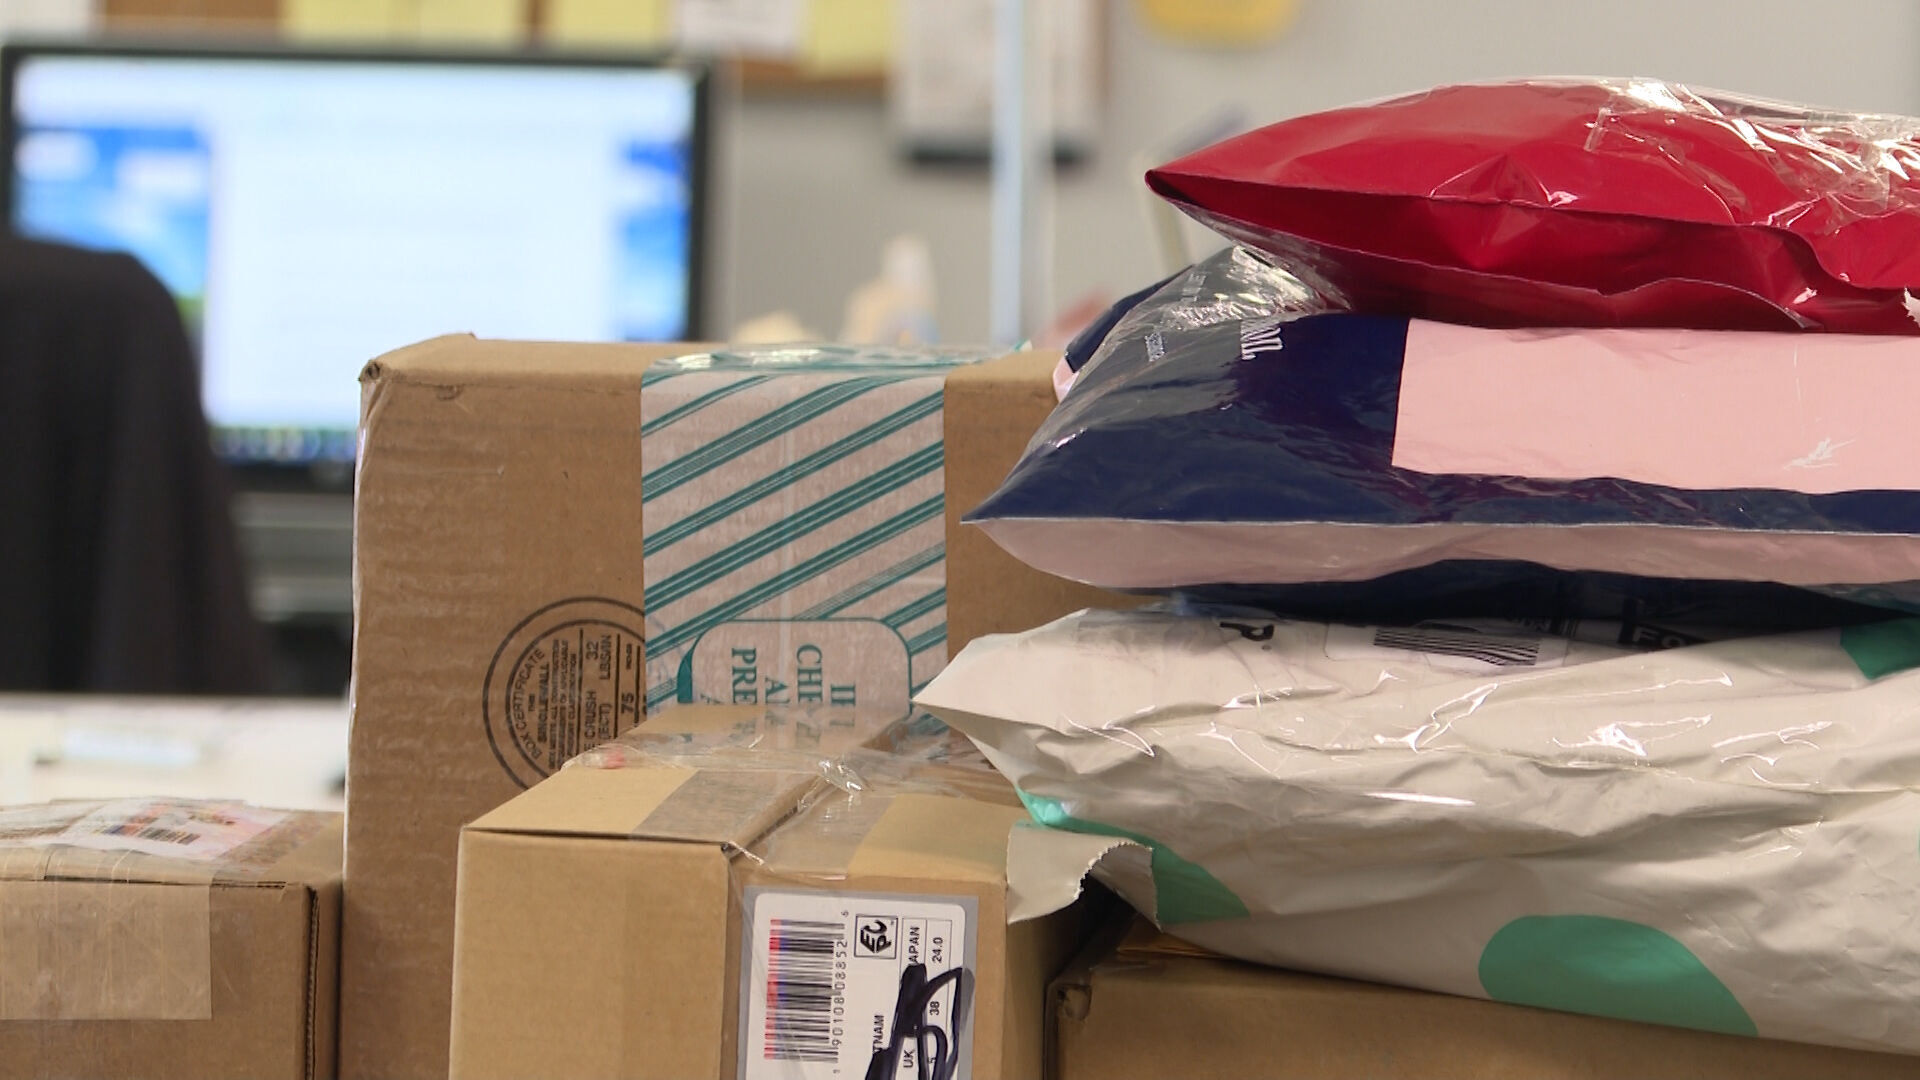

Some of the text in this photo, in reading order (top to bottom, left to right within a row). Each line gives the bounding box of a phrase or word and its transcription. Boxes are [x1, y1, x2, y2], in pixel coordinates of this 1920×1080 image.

[585, 641, 599, 661] 32
[1631, 627, 1685, 650] FO
[731, 647, 758, 705] PRE
[796, 644, 824, 703] CHE
[512, 648, 545, 760] BOX CERTIFICATE
[537, 662, 550, 743] SINGLEWALL
[584, 690, 597, 739] CRUSH
[598, 703, 612, 740] (ECT)
[621, 692, 634, 714] 75
[909, 926, 920, 965] APAN
[931, 937, 943, 964] 24.0
[929, 1000, 940, 1016] 38
[873, 1015, 885, 1054] TNAM
[903, 1049, 915, 1068] UK
